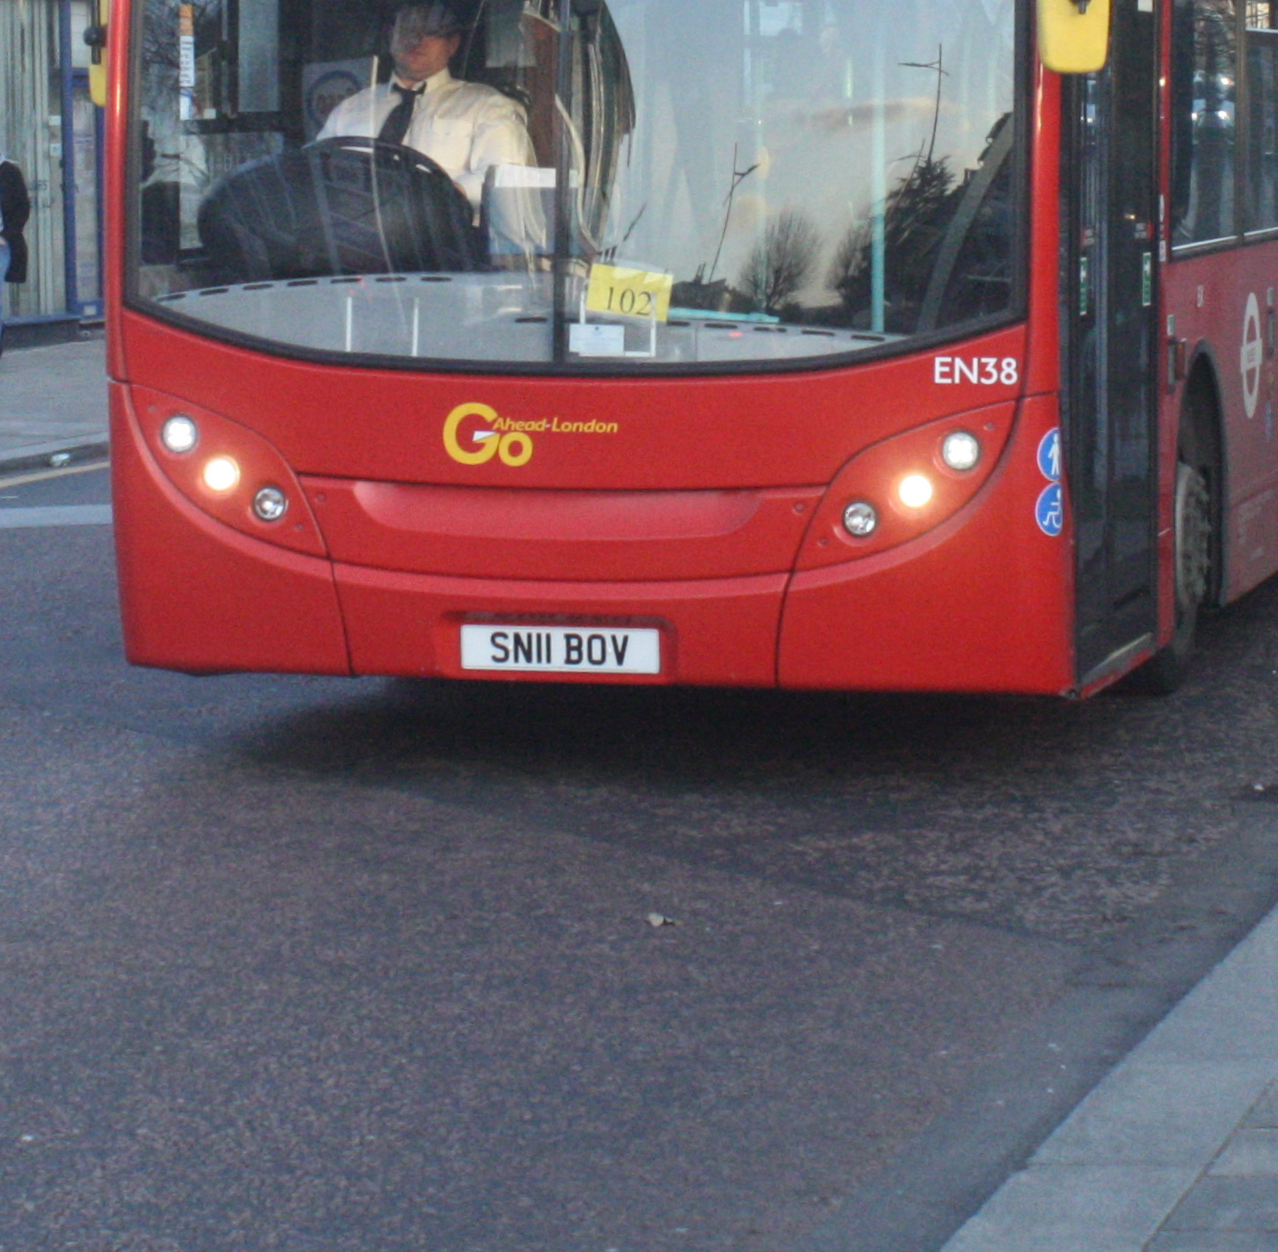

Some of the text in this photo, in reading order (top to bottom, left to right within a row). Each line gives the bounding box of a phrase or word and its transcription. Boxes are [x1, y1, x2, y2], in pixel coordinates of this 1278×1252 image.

[607, 286, 652, 316] 102
[934, 356, 1018, 385] EN38
[443, 402, 533, 467] Go
[490, 631, 629, 666] SN11 BOV
